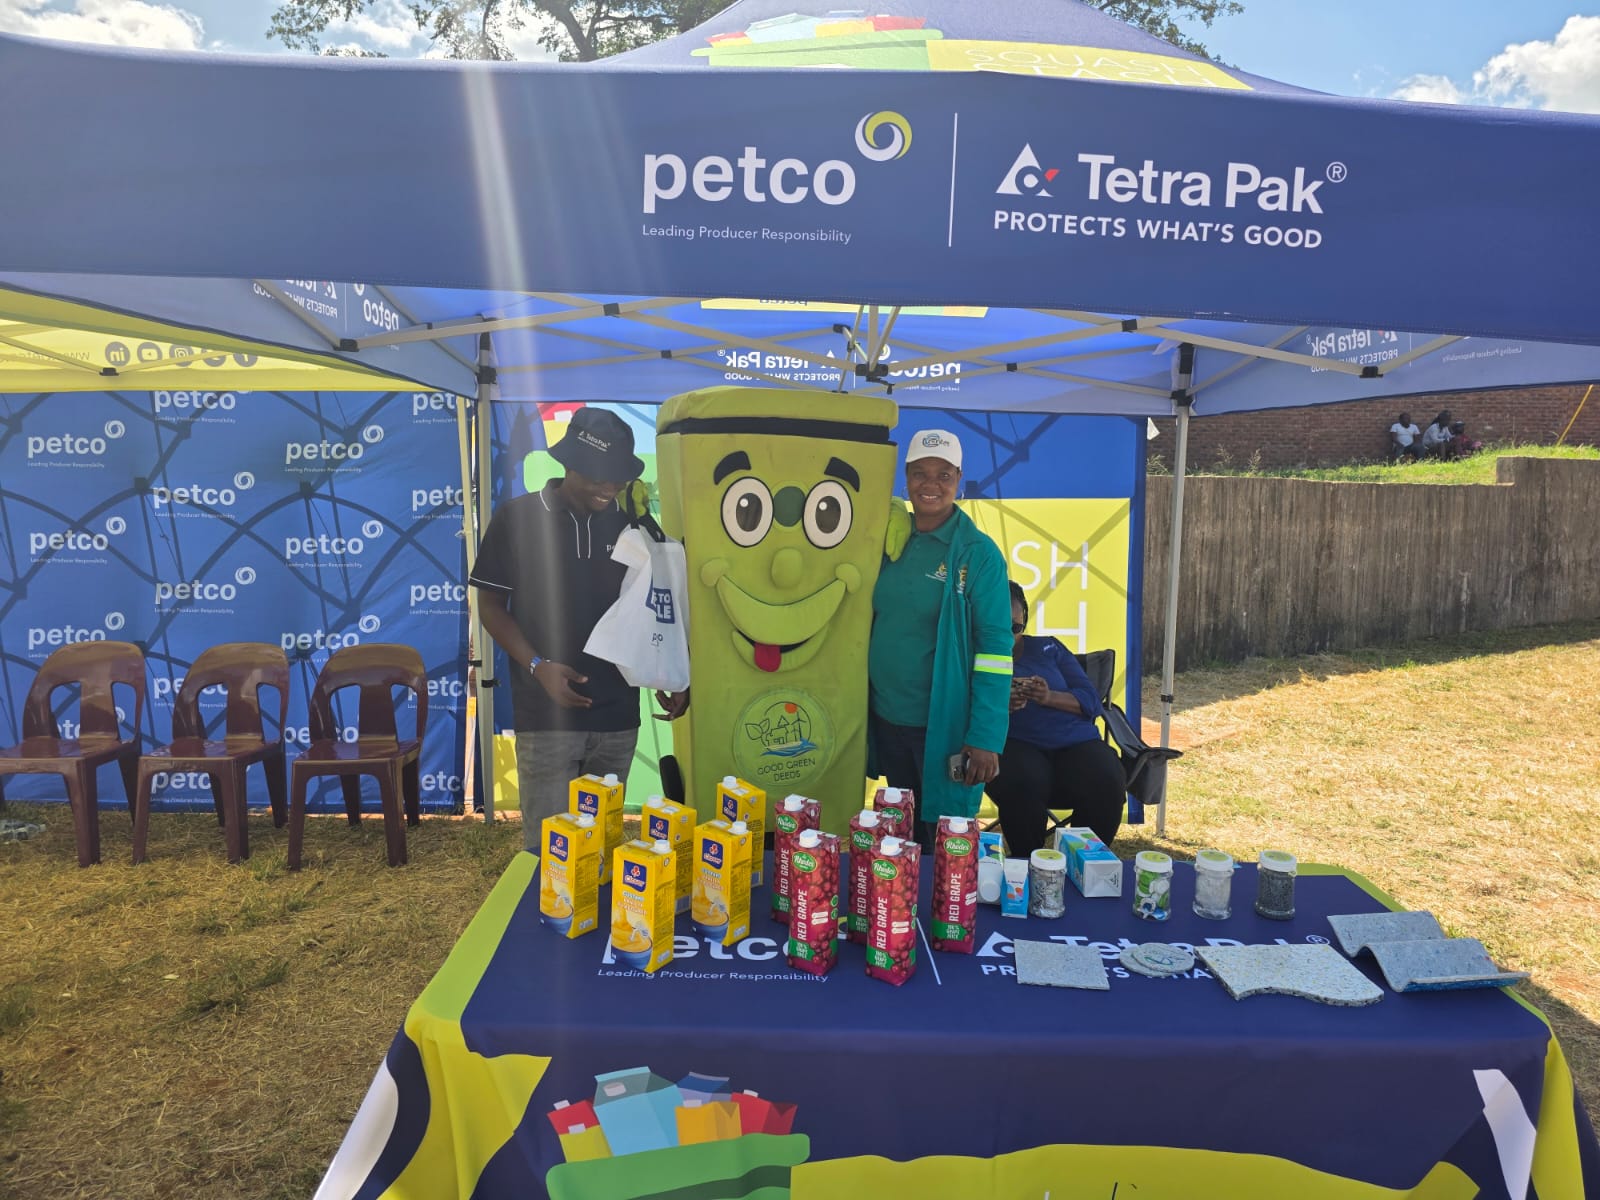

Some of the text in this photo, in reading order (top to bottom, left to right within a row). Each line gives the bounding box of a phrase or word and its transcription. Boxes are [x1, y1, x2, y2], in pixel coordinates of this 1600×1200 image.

[965, 48, 1204, 77] SQUASH
[643, 146, 856, 214] petco
[1078, 152, 1211, 207] Tetra
[642, 224, 851, 245] Leading Producer Responsibility
[994, 210, 1322, 249] PROTECTS WHAT'S GOOD
[154, 390, 236, 413] petco
[28, 433, 106, 459] petco
[285, 439, 364, 465] petco
[153, 484, 236, 509] petco
[30, 529, 108, 555] petco
[285, 534, 364, 559] petco
[155, 579, 237, 605] petco
[410, 581, 468, 607] petc
[28, 625, 106, 650] petco
[281, 629, 360, 651] petco
[757, 757, 816, 775] GOOD GREEN
[773, 770, 801, 782] DEEDS
[945, 840, 969, 851] Rhodes
[780, 848, 790, 876] GRAPE
[780, 877, 788, 896] RED
[857, 866, 867, 916] RED GRAPE
[949, 873, 961, 922] RED GRAPE
[797, 889, 808, 941] RED GRAPE
[876, 896, 888, 949] RED GRAPE
[597, 969, 829, 983] Leading Producer Responsibility
